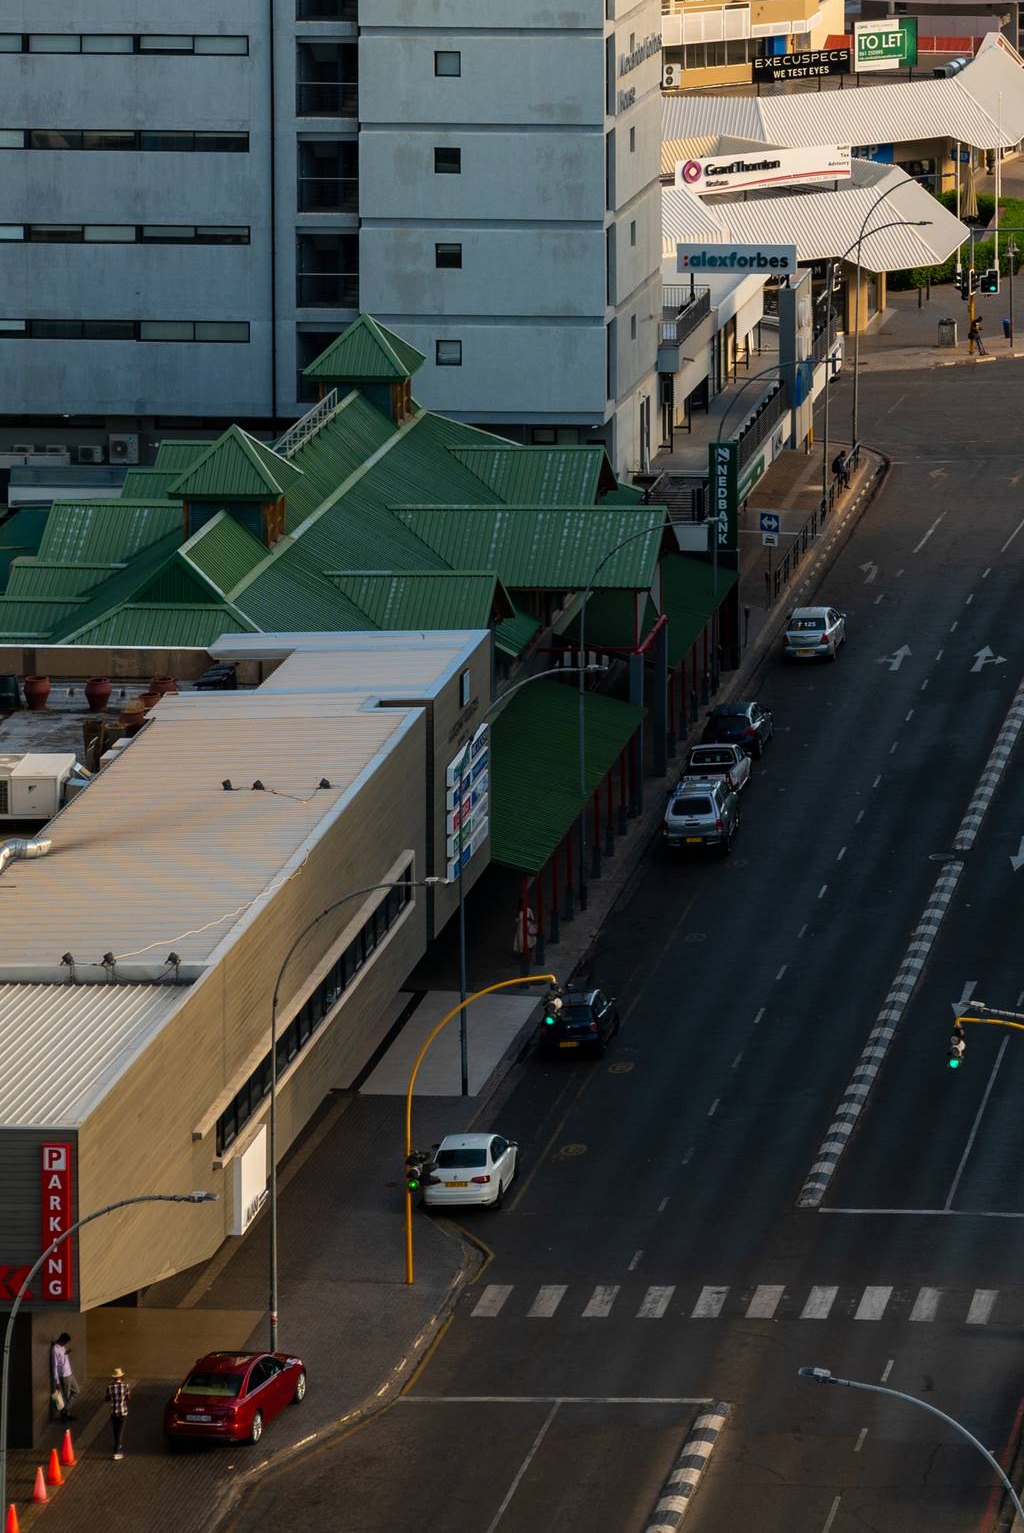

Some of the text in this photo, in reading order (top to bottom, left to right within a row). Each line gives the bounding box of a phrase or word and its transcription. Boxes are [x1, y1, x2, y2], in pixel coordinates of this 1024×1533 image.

[859, 33, 903, 50] TO LET
[754, 50, 848, 69] EXECUSPECS
[773, 65, 830, 78] WE TEST EYES
[717, 465, 729, 545] NEDBANK
[48, 1149, 63, 1296] PARKING
